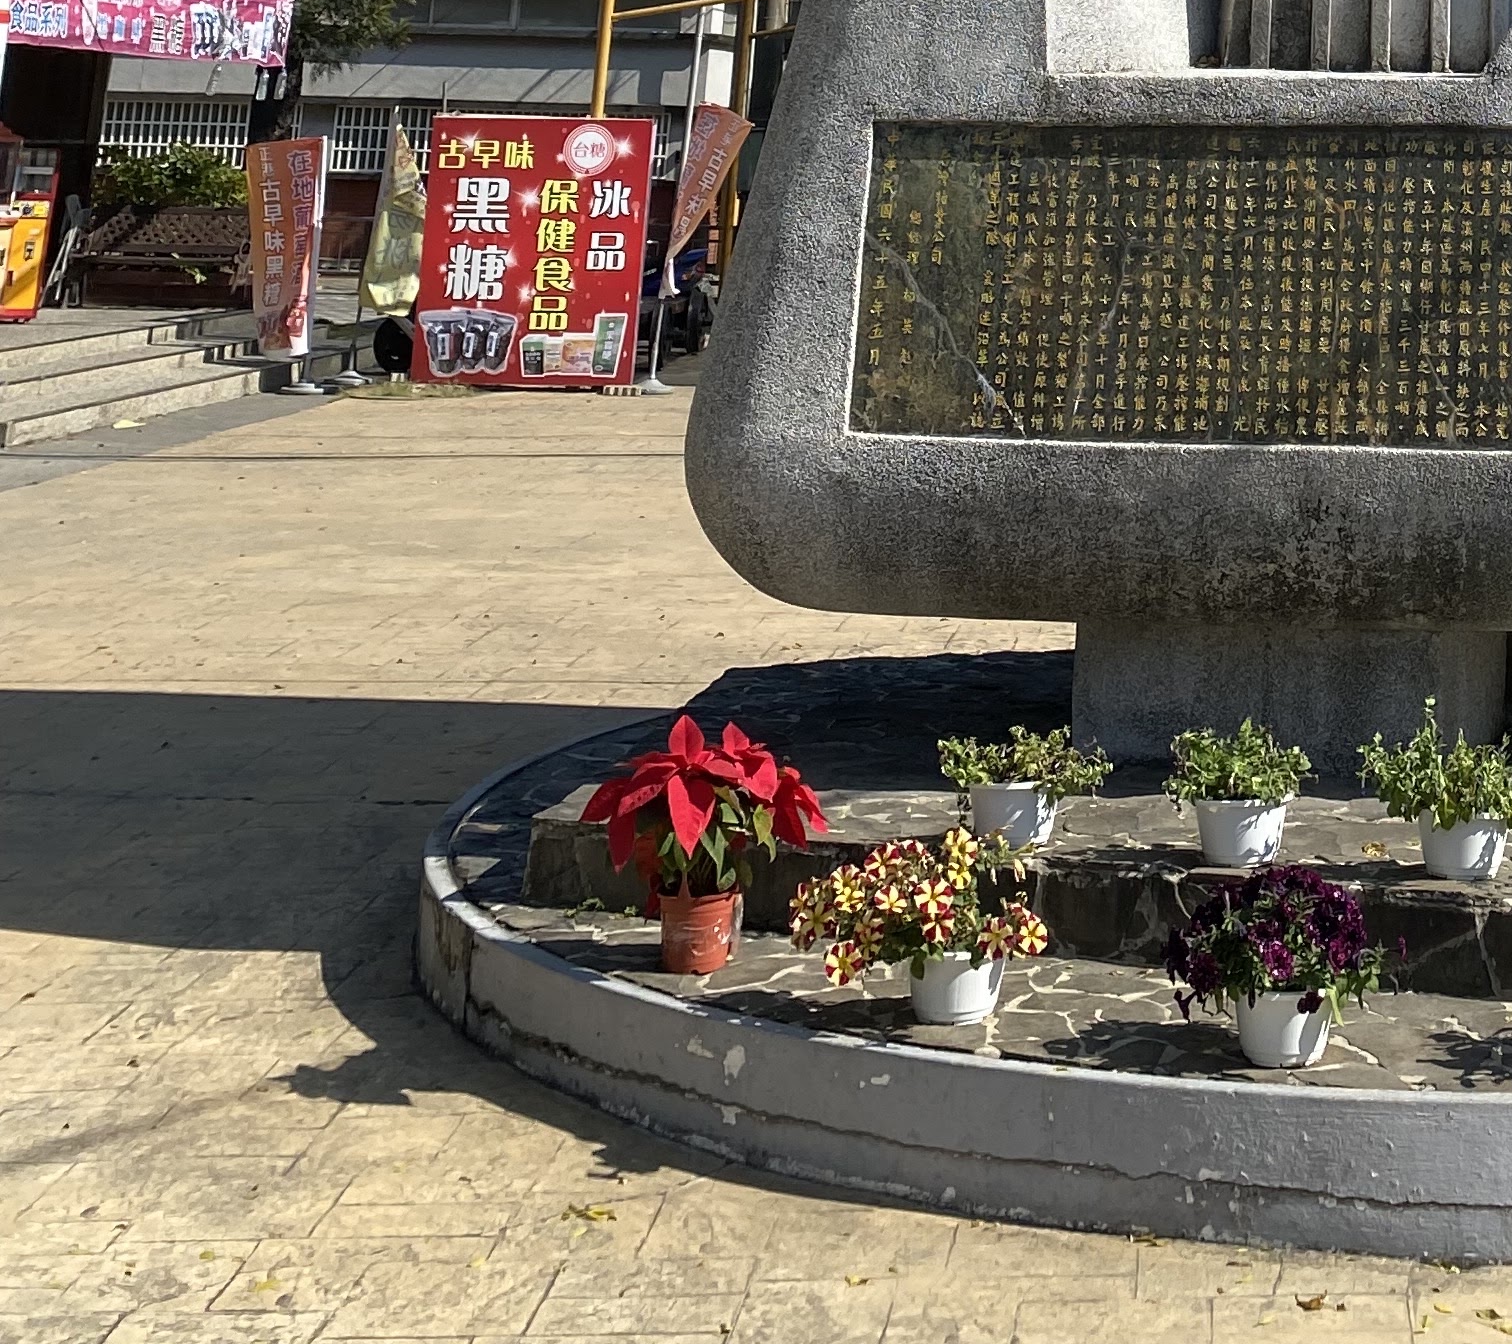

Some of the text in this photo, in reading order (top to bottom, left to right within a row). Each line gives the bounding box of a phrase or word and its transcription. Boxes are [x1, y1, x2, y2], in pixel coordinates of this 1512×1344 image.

[9, 0, 69, 39] 食品系列
[438, 140, 536, 170] 古早味
[573, 141, 606, 159] 台糖
[443, 177, 510, 301] 黑糖
[529, 179, 580, 331] 保健食品
[586, 180, 632, 271] 冰品
